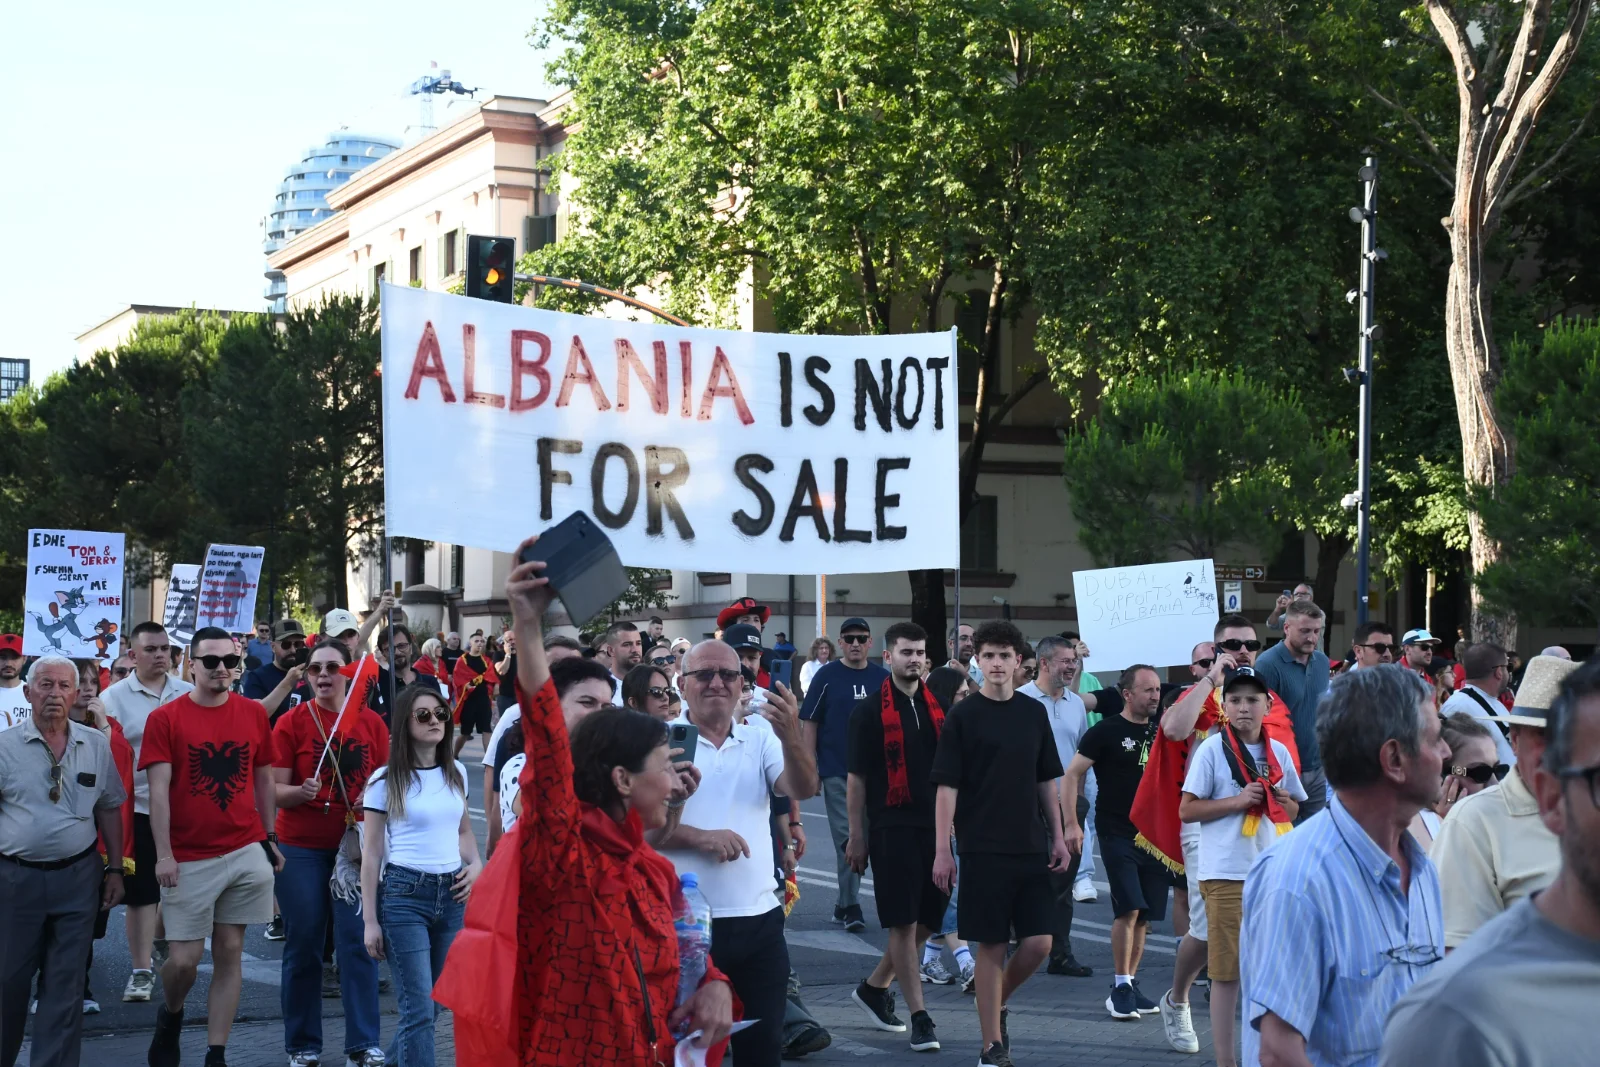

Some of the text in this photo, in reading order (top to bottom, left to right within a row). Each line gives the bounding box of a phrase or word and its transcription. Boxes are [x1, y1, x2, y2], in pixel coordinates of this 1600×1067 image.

[405, 320, 950, 433] ALBANIA IS NOT
[536, 436, 911, 543] FOR SALE
[33, 533, 65, 547] EDHE
[67, 545, 111, 557] TOM &
[210, 549, 236, 558] Taulant,
[81, 556, 117, 566] JERRY
[98, 595, 120, 606] MIRË
[1110, 598, 1183, 626] ALBANIA
[852, 684, 868, 697] LA
